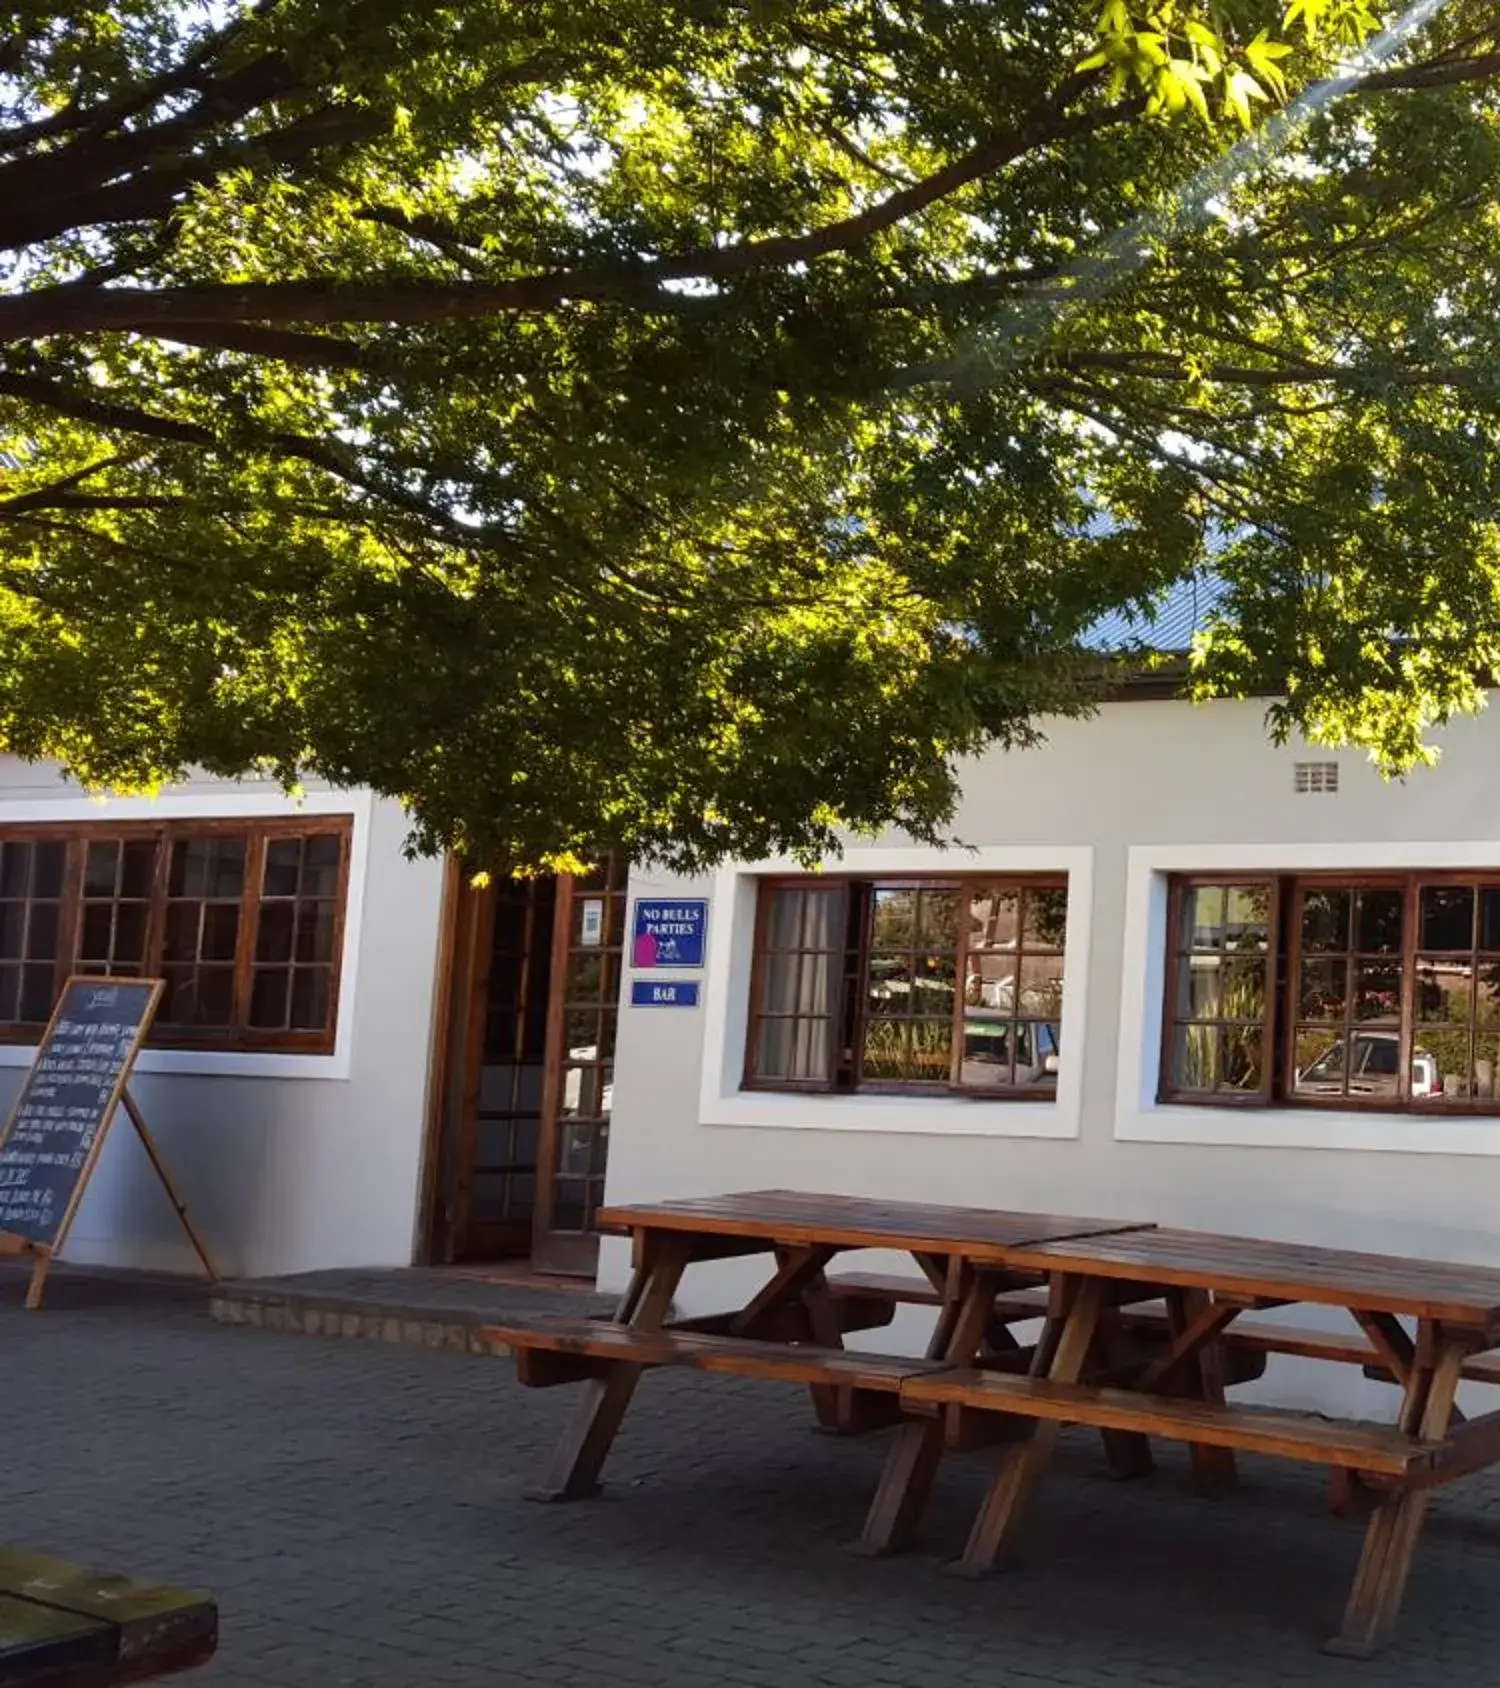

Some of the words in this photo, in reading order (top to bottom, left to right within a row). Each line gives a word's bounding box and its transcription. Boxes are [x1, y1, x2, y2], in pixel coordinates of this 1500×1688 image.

[643, 909, 661, 921] NO
[646, 923, 695, 935] PARTIES
[653, 987, 677, 1001] BAR
